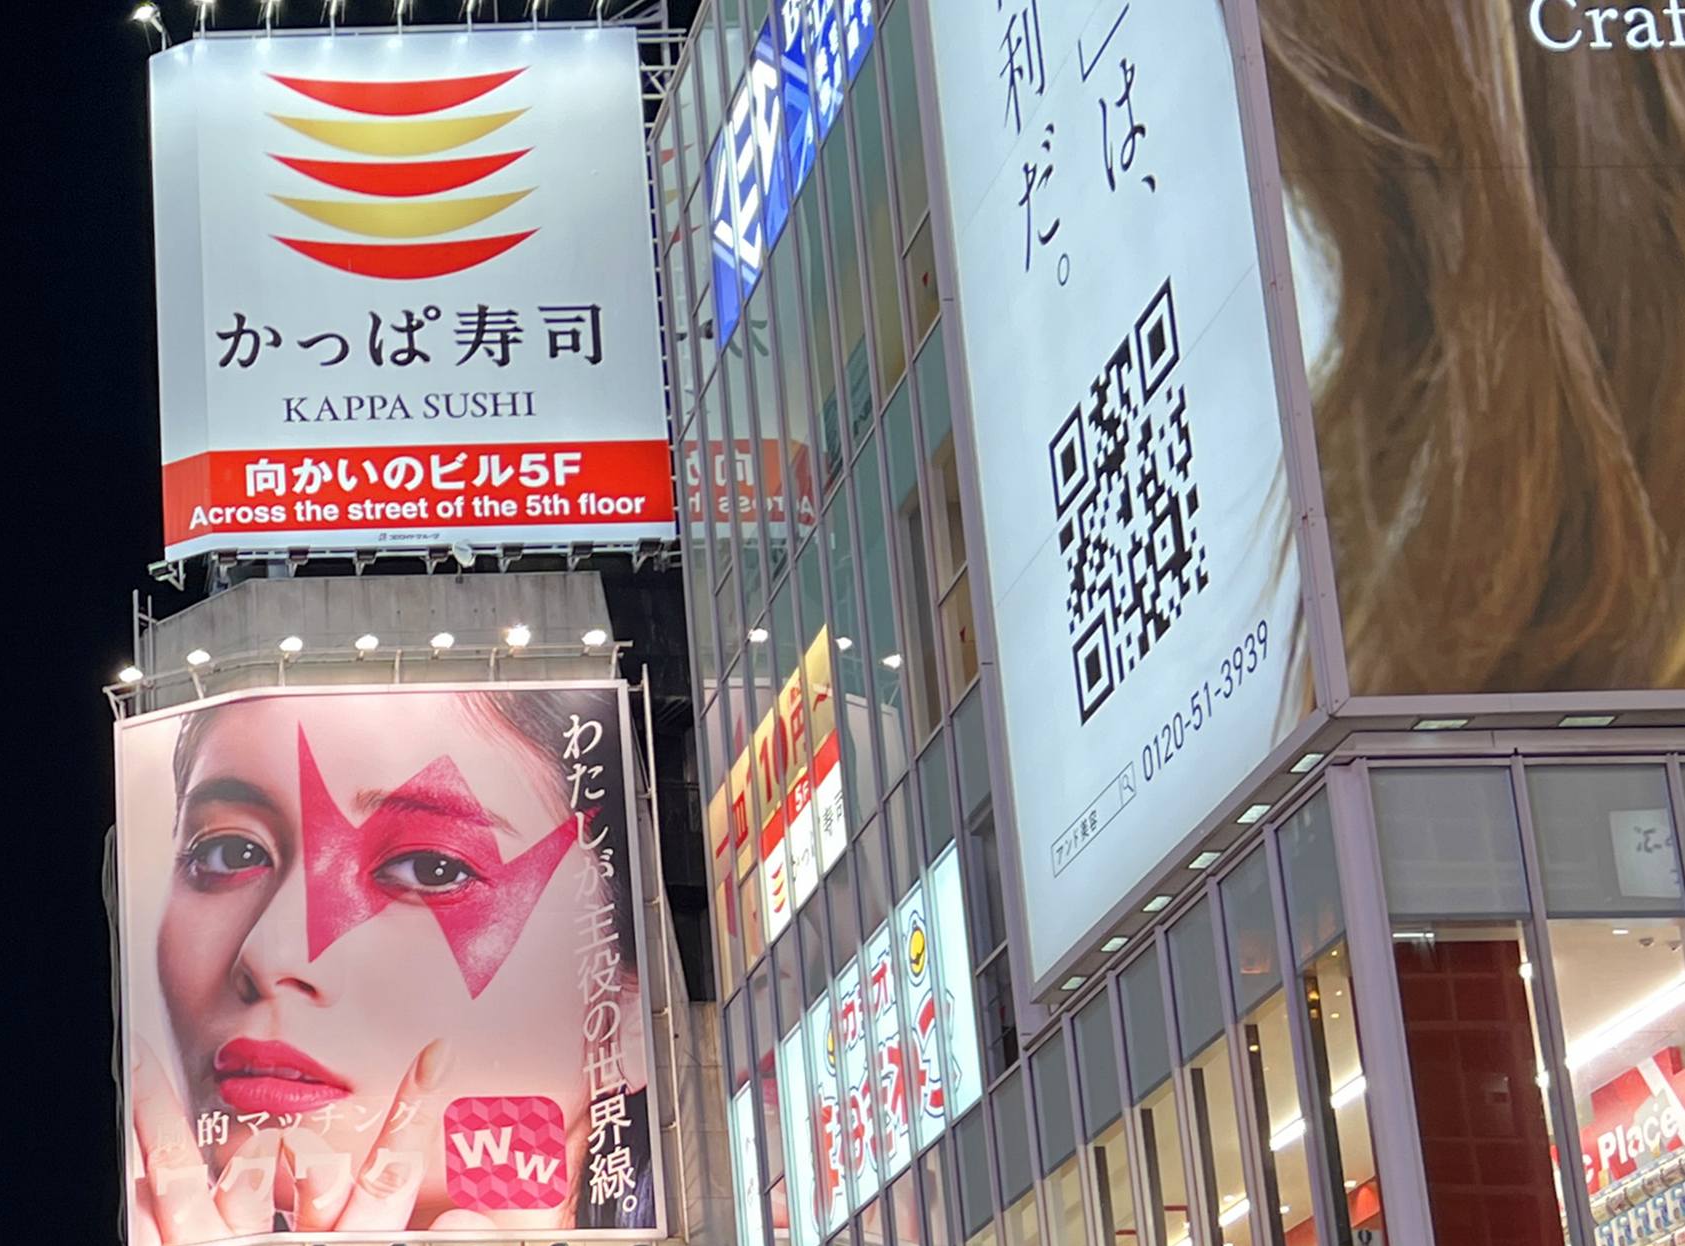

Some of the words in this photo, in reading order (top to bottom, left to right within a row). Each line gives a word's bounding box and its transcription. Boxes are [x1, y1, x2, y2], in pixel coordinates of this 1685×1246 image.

[998, 0, 1071, 286] 利だ。
[217, 304, 604, 369] かっぱ寿司
[283, 395, 414, 423] KAPPA
[423, 391, 537, 419] SUSHI
[246, 452, 582, 497] 向かいのビル5F
[189, 505, 286, 529] Across
[295, 501, 340, 522] the
[349, 499, 429, 522] street
[436, 497, 466, 518] of
[472, 496, 519, 517] the
[526, 494, 570, 517] 5th
[578, 493, 646, 515] floor
[1142, 619, 1268, 782] 0120-51-3939
[562, 713, 636, 1215] わたしが主役の世界線。
[161, 1098, 423, 1148] 的マッチング
[1596, 1105, 1679, 1171] Place
